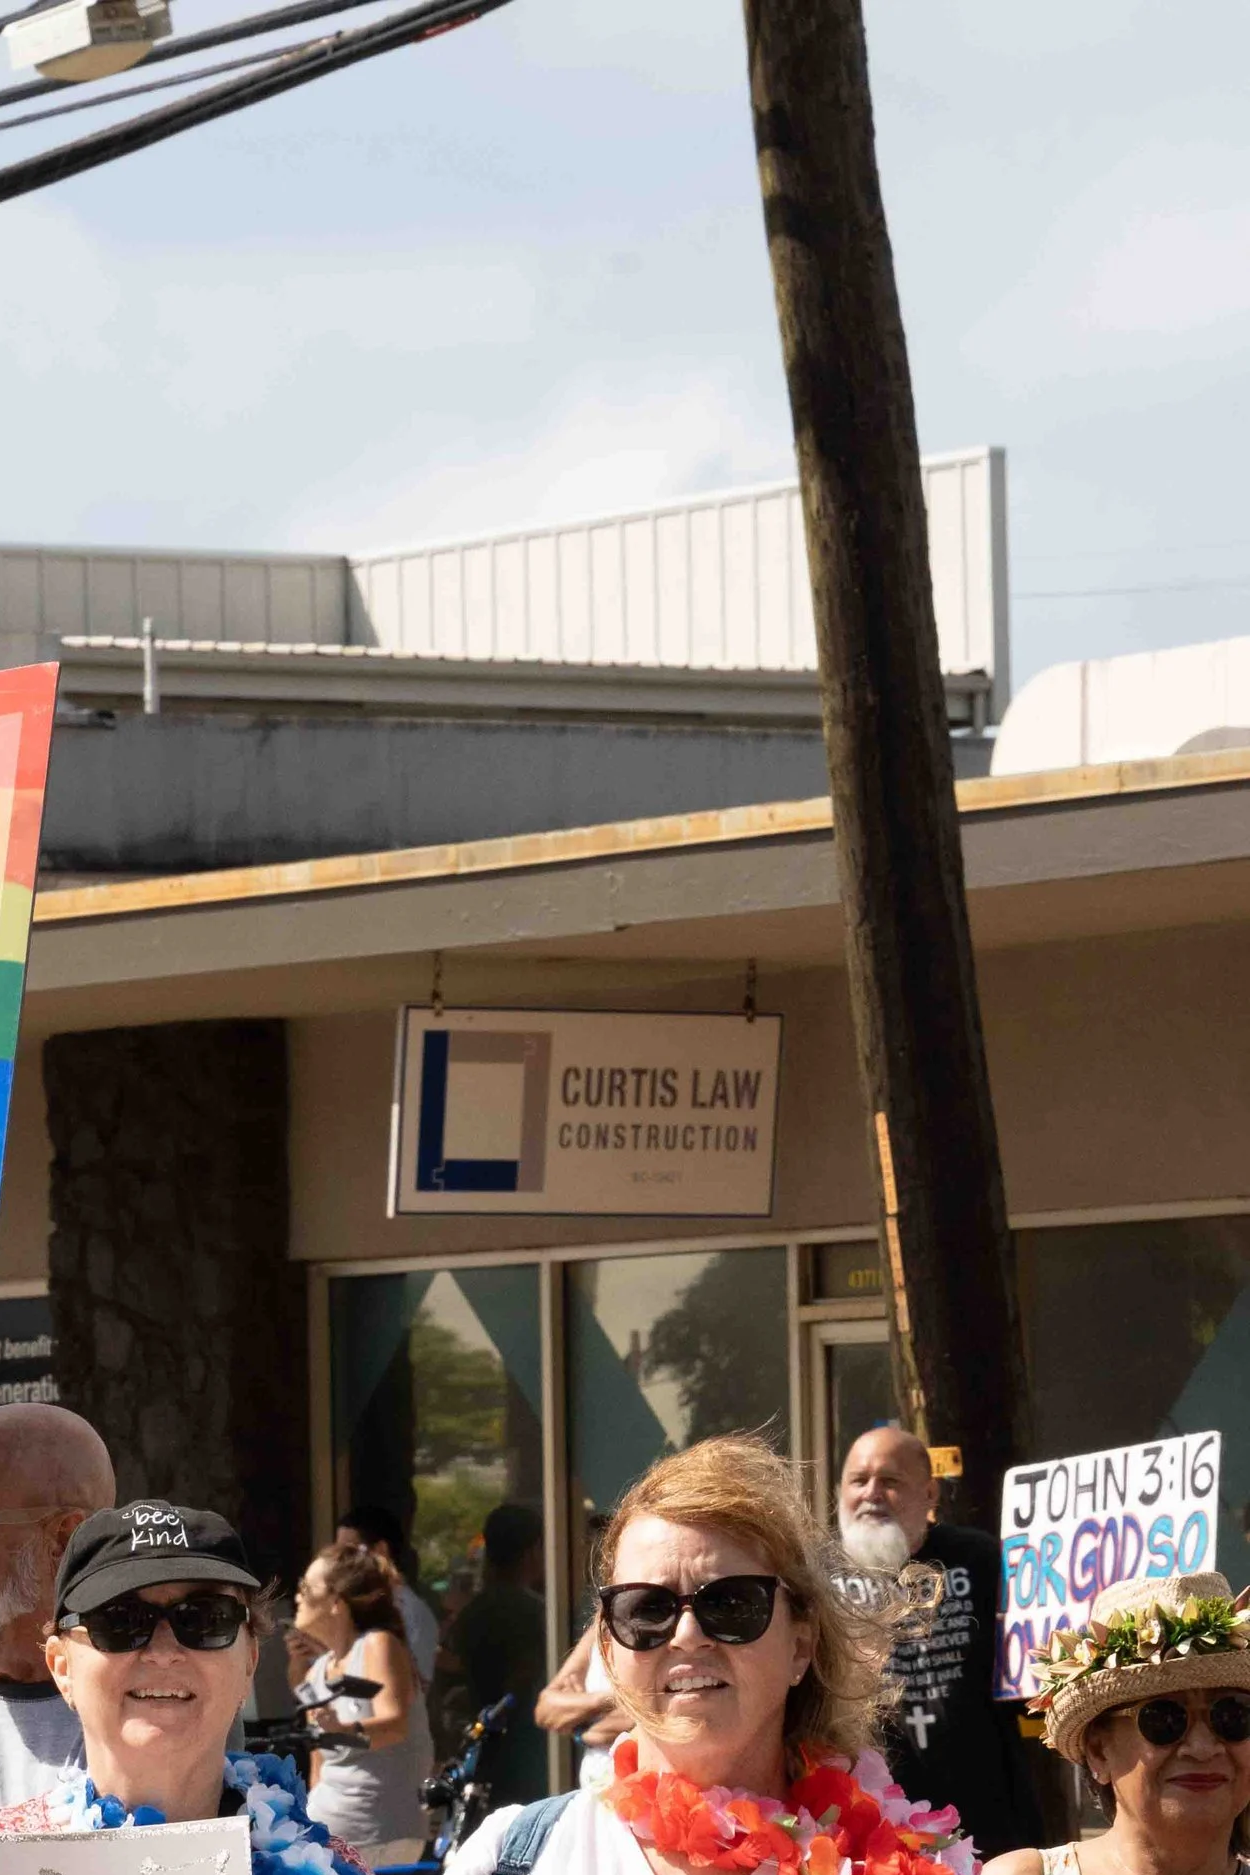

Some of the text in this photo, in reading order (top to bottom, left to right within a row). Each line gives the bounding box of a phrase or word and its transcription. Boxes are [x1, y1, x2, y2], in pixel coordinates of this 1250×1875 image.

[561, 1066, 762, 1110] CURTIS LAW
[558, 1122, 758, 1152] CONSTRUCTION
[1013, 1435, 1215, 1529] JOHN 3:16
[135, 1510, 180, 1526] bee
[1000, 1510, 1210, 1614] FOR GOD SO
